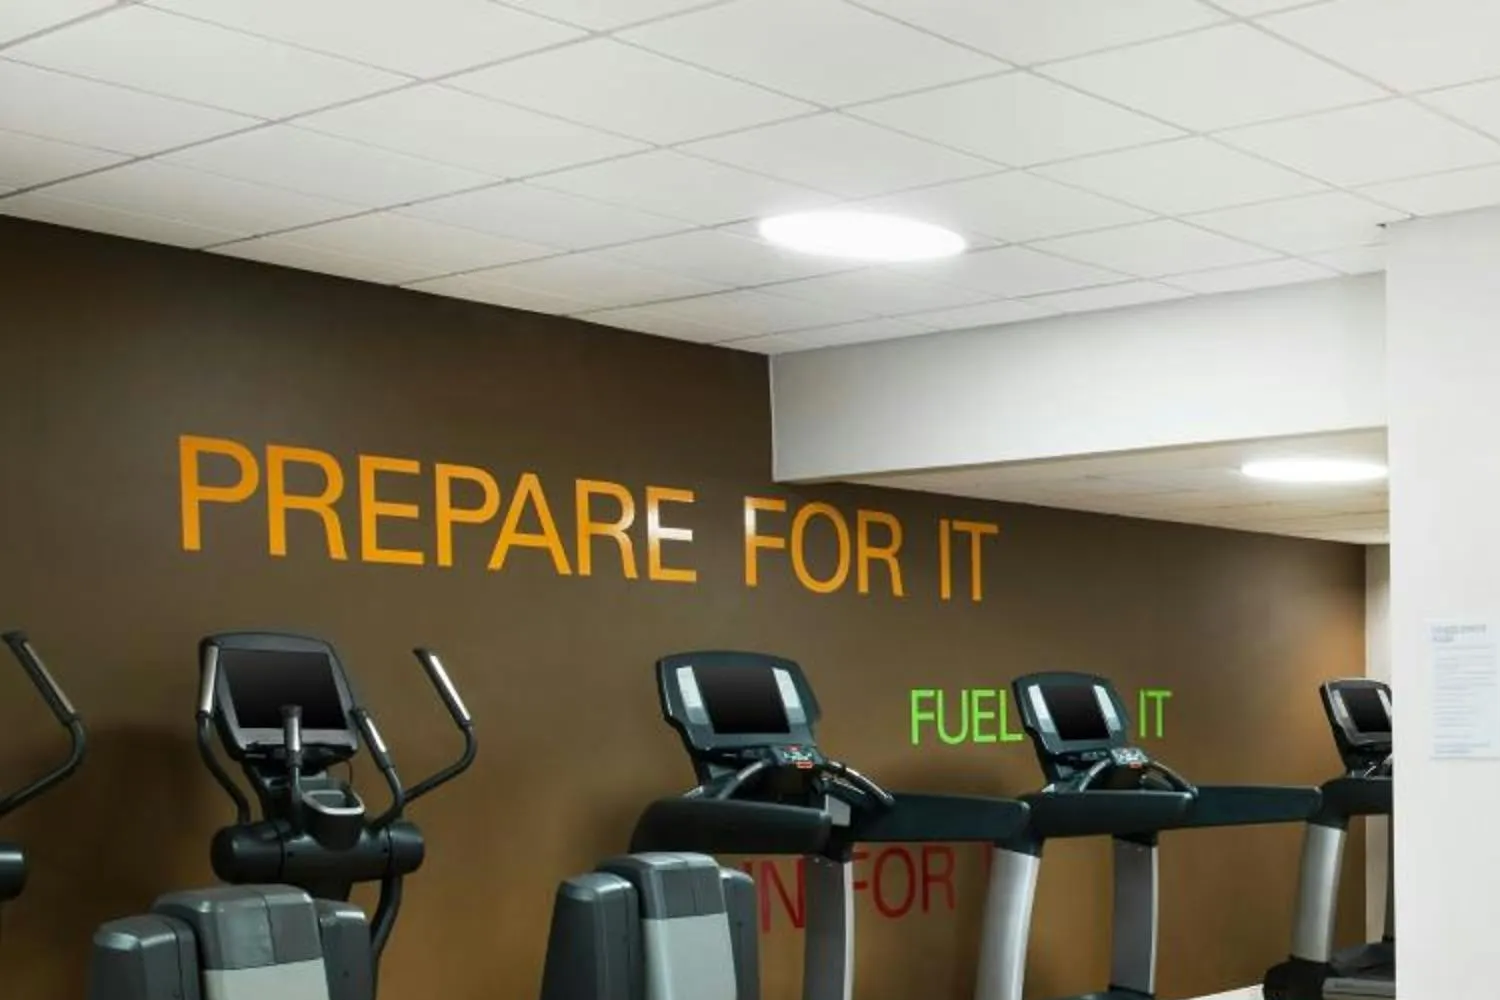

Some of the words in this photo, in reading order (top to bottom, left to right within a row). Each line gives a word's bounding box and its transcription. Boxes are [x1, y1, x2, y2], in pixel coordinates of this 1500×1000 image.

[179, 435, 698, 582] PREPARE
[744, 495, 905, 597] FOR
[938, 519, 999, 601] IT
[910, 689, 1024, 745] FUEL
[1138, 690, 1173, 738] IT
